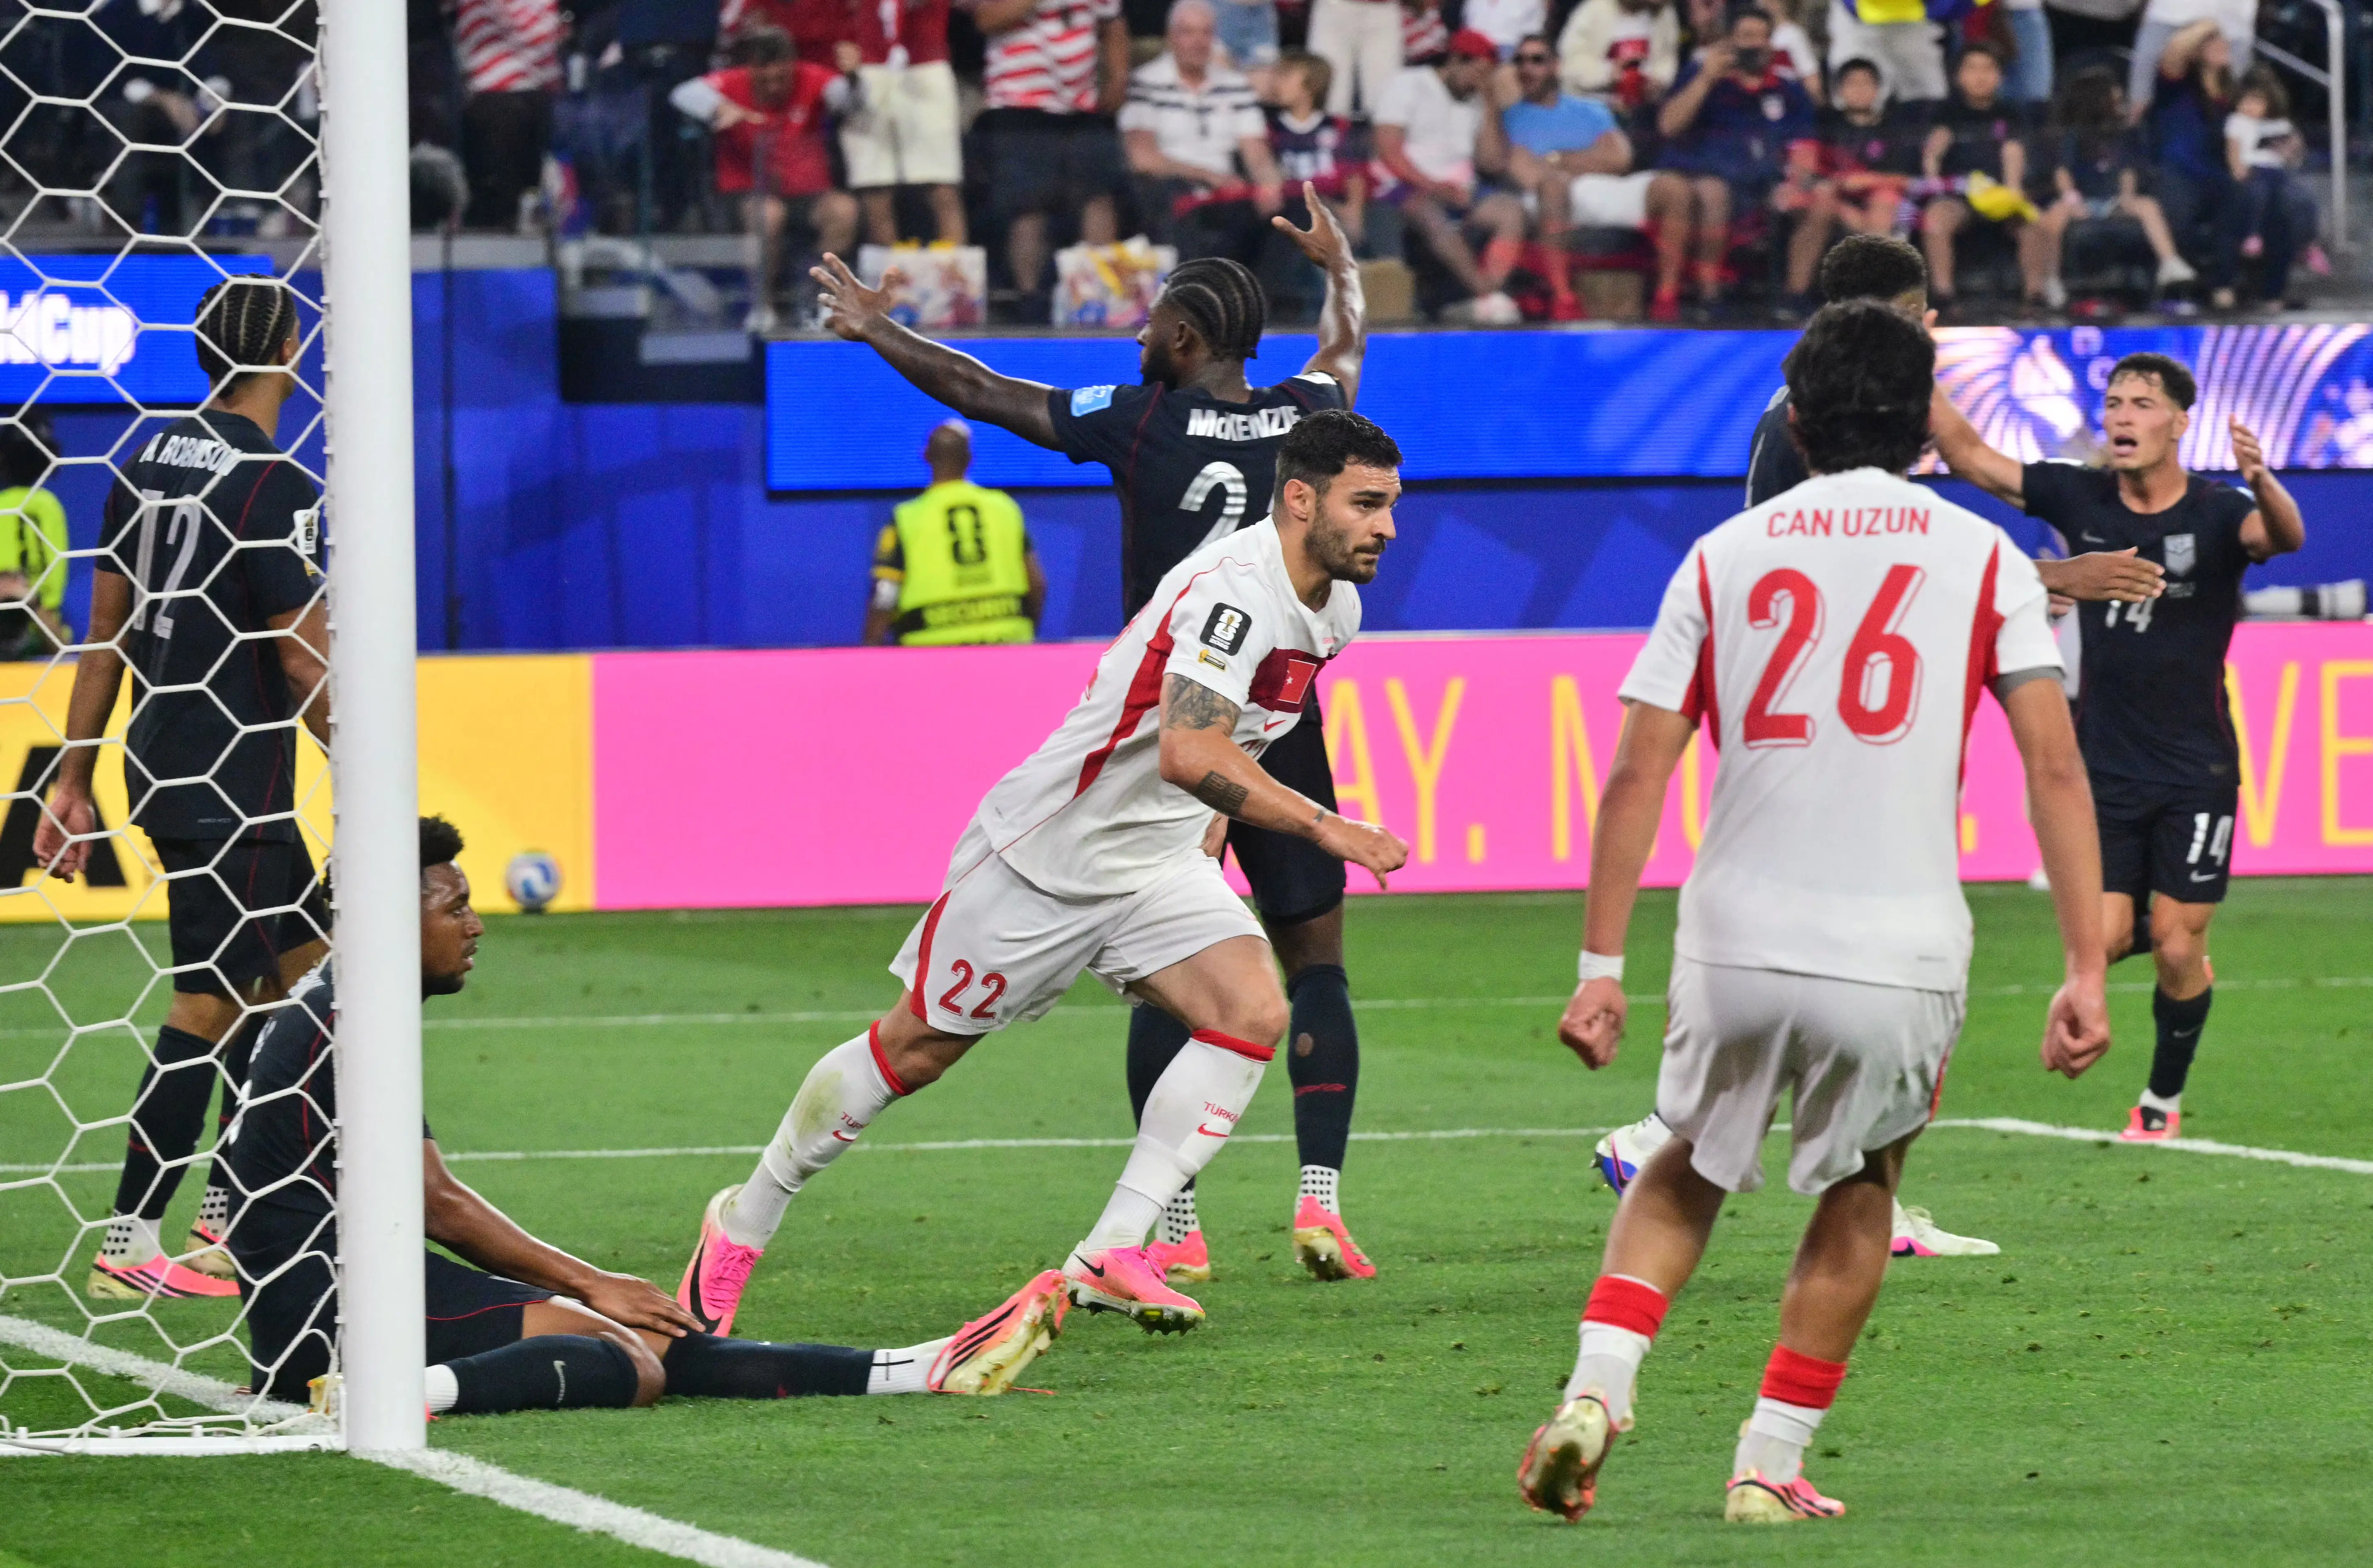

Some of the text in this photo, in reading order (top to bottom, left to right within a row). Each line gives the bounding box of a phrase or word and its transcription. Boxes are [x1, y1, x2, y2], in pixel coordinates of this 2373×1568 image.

[1767, 507, 1930, 537] CAN UZUN
[132, 488, 202, 640] 12
[1742, 563, 1927, 751] 26
[2186, 812, 2233, 867] 14
[938, 958, 1008, 1020] 22
